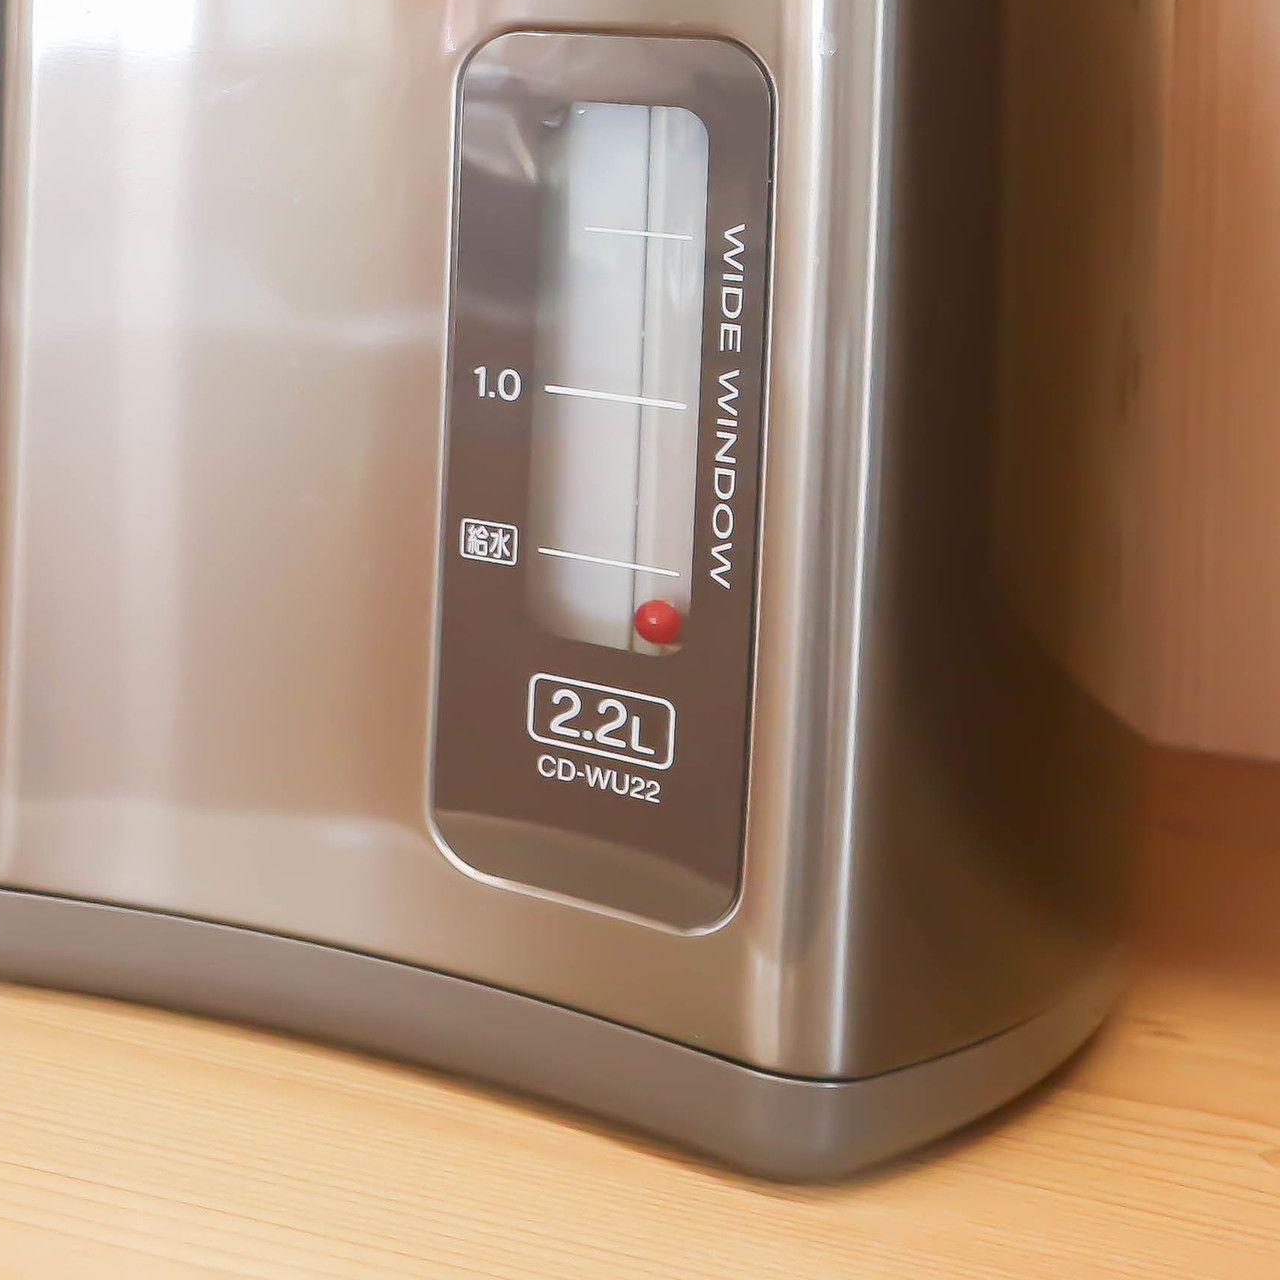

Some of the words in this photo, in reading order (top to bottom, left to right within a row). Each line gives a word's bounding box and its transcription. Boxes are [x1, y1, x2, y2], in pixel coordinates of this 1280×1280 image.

[719, 224, 746, 352] WIDE
[473, 366, 523, 401] 1.0
[710, 370, 741, 590] WINDOW
[466, 524, 511, 559] 給水
[550, 689, 655, 755] 2.2L
[538, 754, 661, 803] CD-WU22
